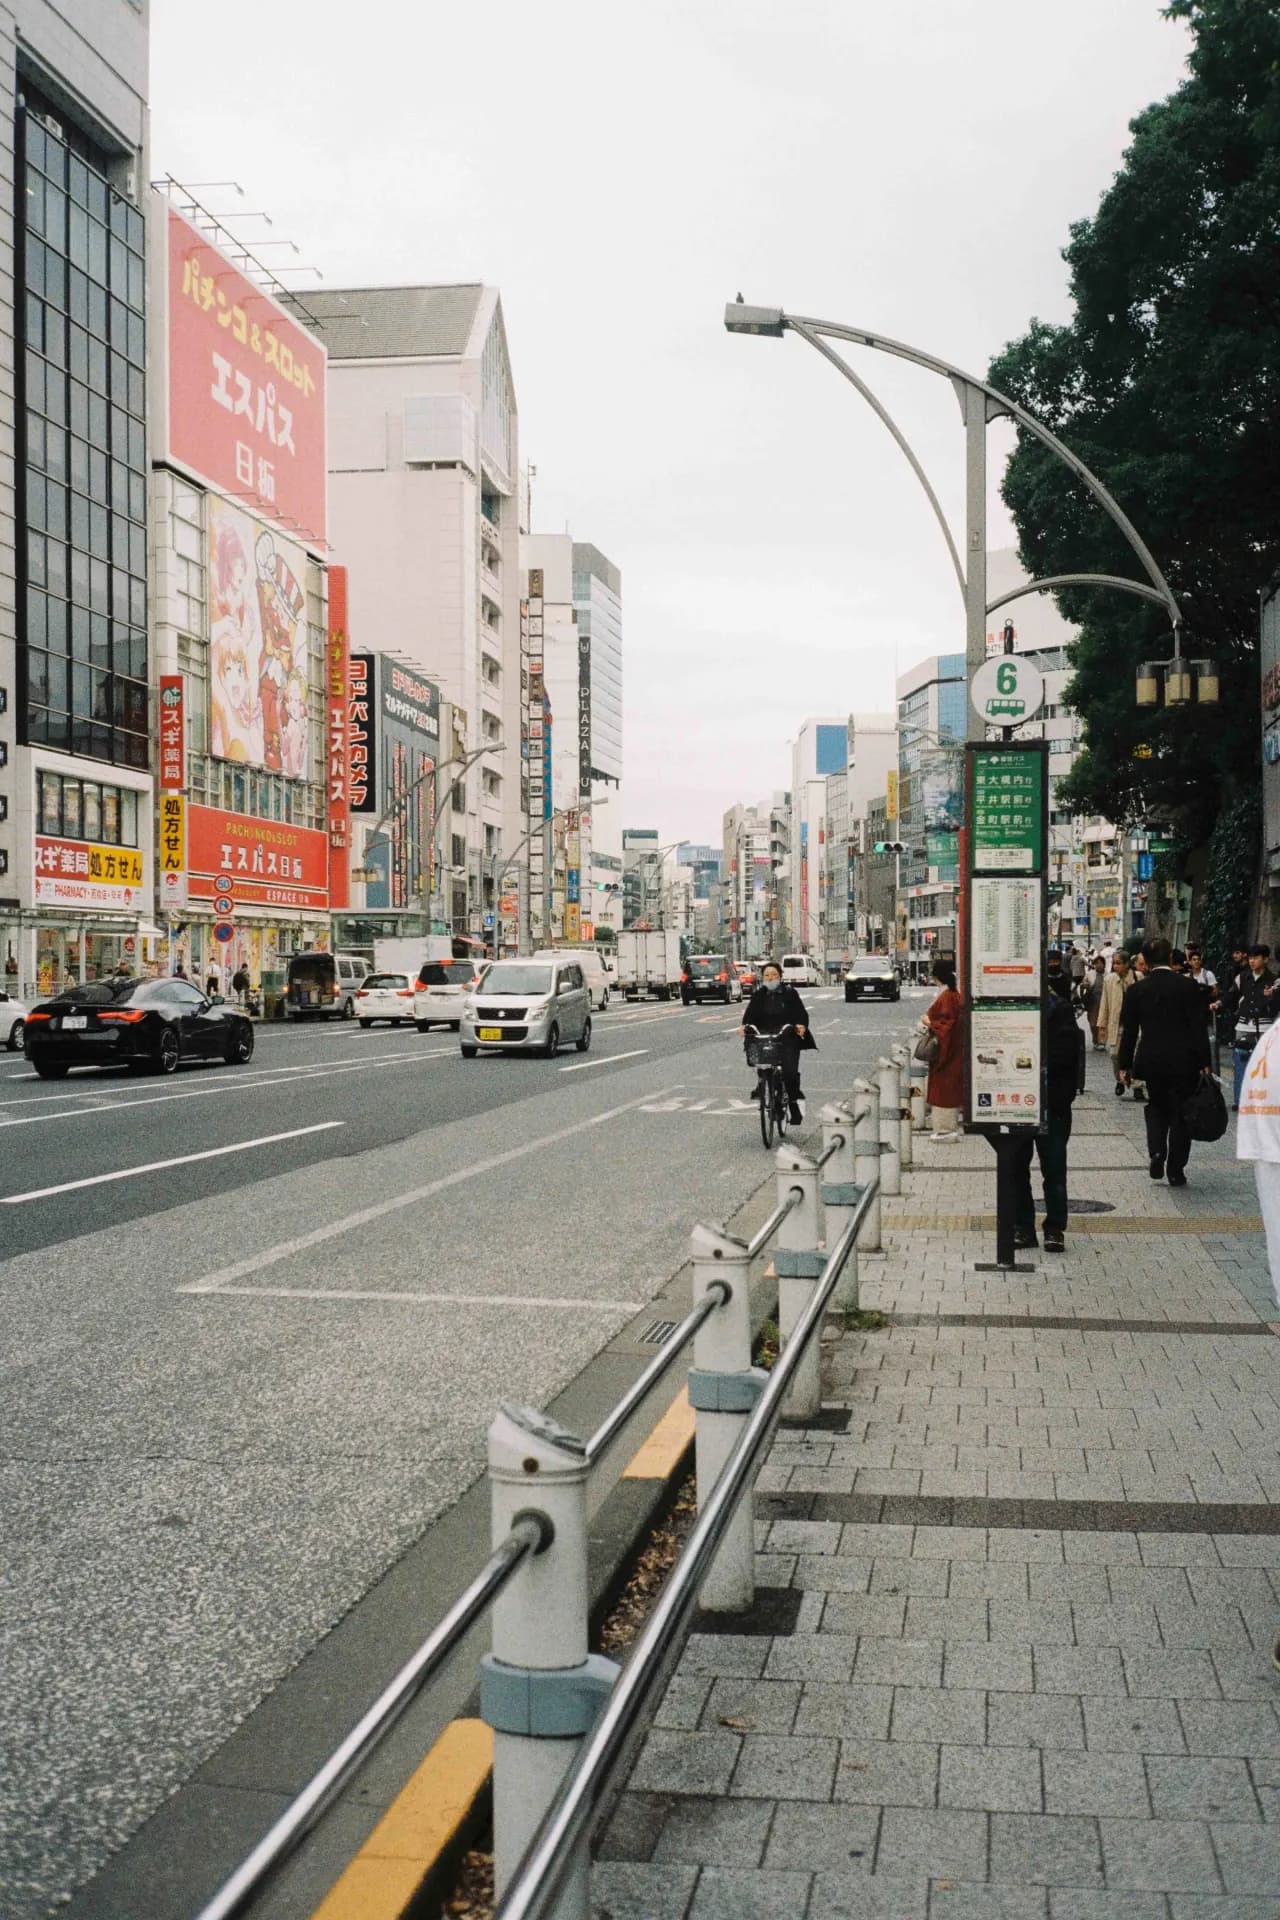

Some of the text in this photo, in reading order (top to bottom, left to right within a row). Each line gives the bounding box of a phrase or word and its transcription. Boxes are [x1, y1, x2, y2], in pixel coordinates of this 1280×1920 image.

[211, 351, 296, 457] エスパス
[236, 440, 275, 502] 日拓
[996, 662, 1017, 695] 6
[163, 710, 181, 780] スギ薬局
[350, 660, 368, 806] ヨドバシカメラ
[580, 687, 590, 750] PLAZA
[330, 708, 345, 801] エスパス
[164, 800, 180, 869] 処方せん
[220, 843, 303, 880] エスパス日拓
[90, 851, 142, 881] 処方せん
[218, 879, 229, 889] 50
[266, 890, 296, 902] ESPACE
[1077, 897, 1085, 908] P
